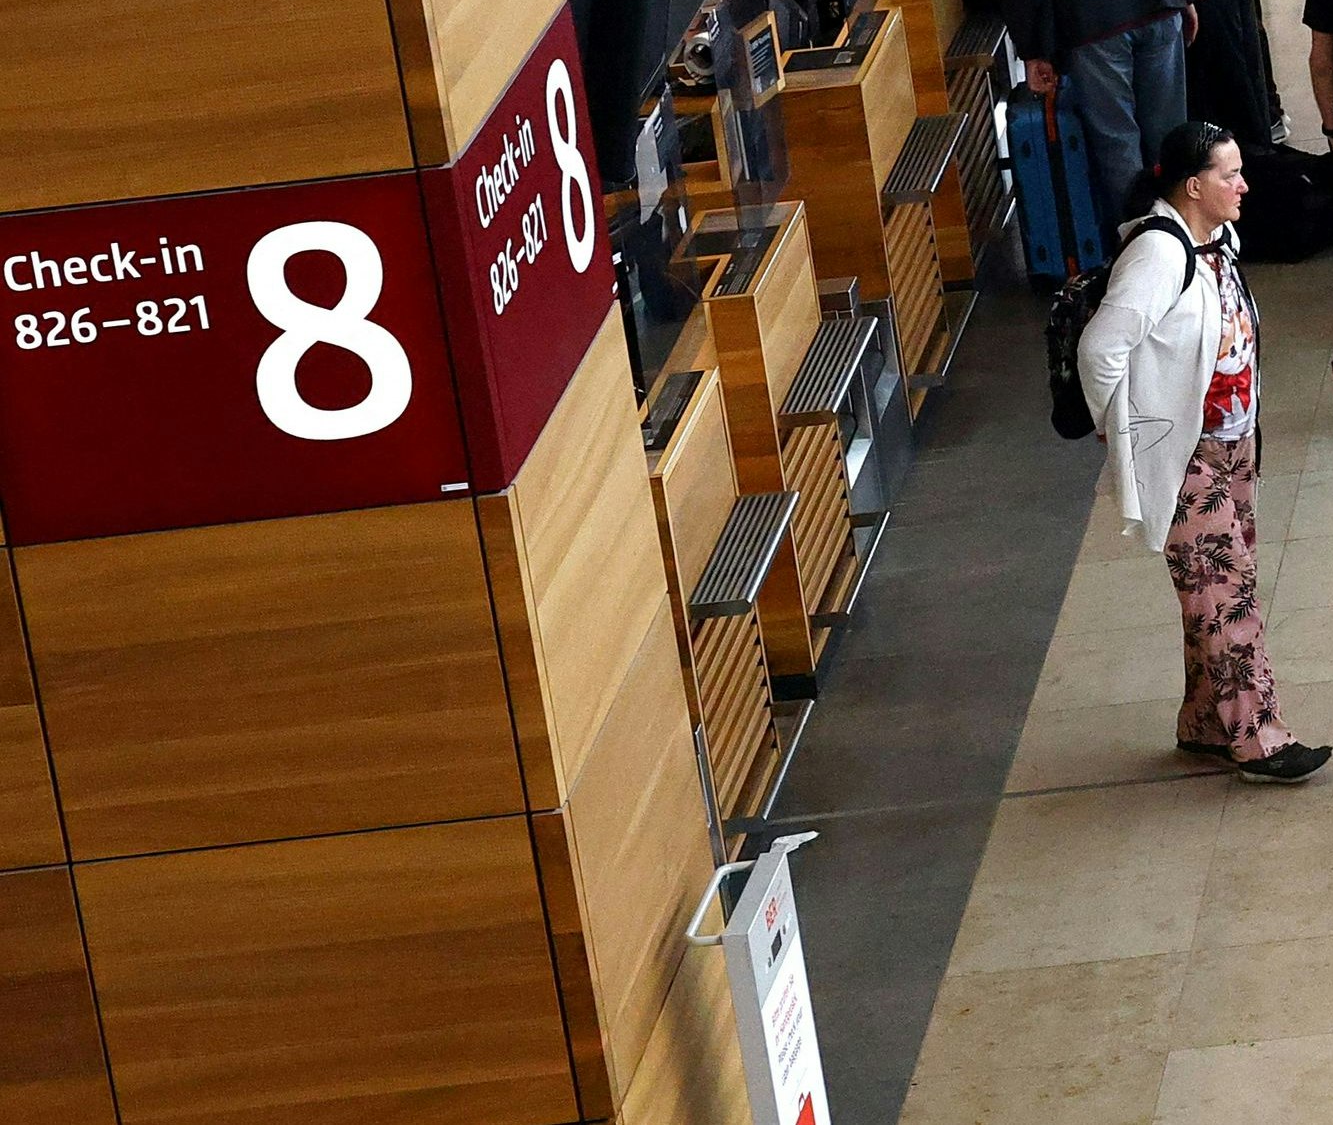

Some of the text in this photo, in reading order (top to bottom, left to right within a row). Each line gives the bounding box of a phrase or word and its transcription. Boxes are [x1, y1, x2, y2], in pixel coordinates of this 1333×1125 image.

[474, 115, 534, 229] Check-in
[545, 58, 596, 275] 8
[3, 237, 204, 292] Check-in
[14, 295, 211, 351] 826–821
[246, 220, 413, 441] 8
